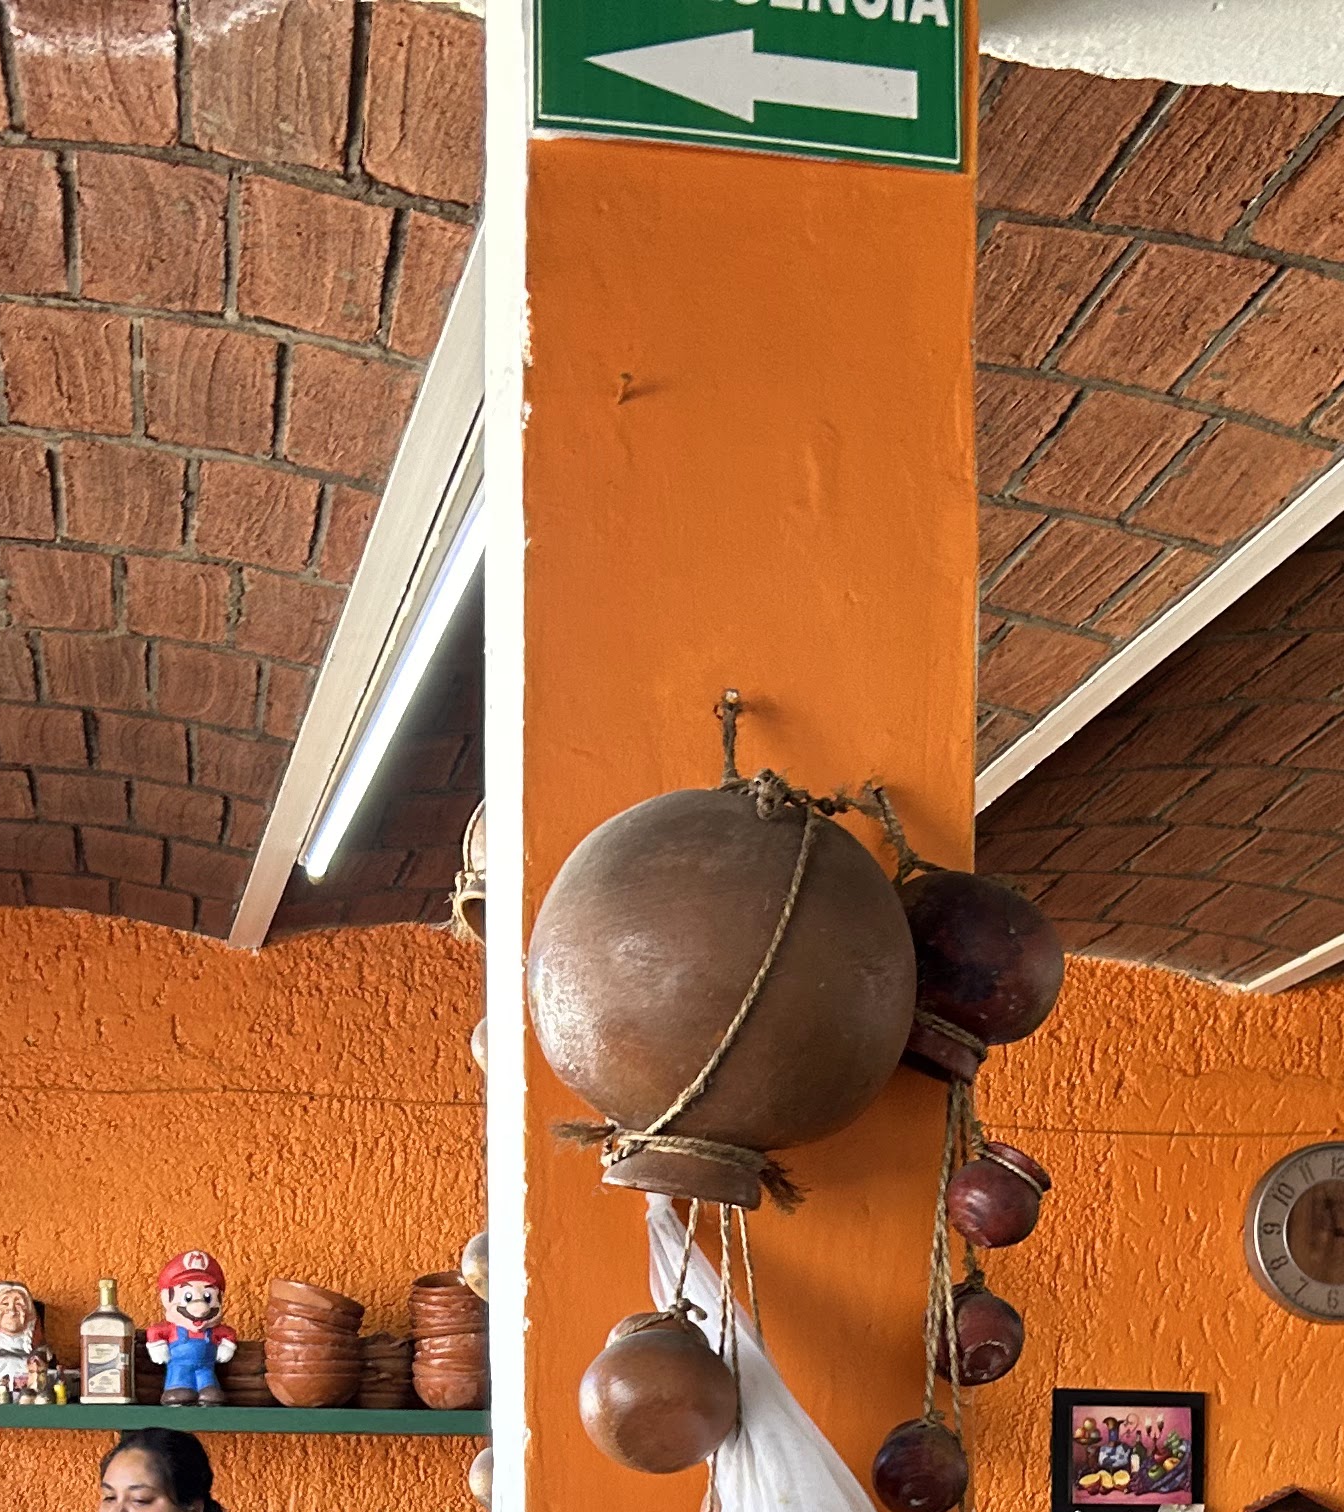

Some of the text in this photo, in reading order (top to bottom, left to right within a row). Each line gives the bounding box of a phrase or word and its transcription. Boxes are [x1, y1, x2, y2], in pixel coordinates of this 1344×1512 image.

[1298, 1161, 1316, 1185] 11
[1272, 1183, 1295, 1206] 10
[1263, 1222, 1283, 1236] 9
[188, 1252, 206, 1268] M
[1270, 1255, 1289, 1271] 8
[1294, 1277, 1309, 1297] 7
[1327, 1289, 1339, 1310] 6
